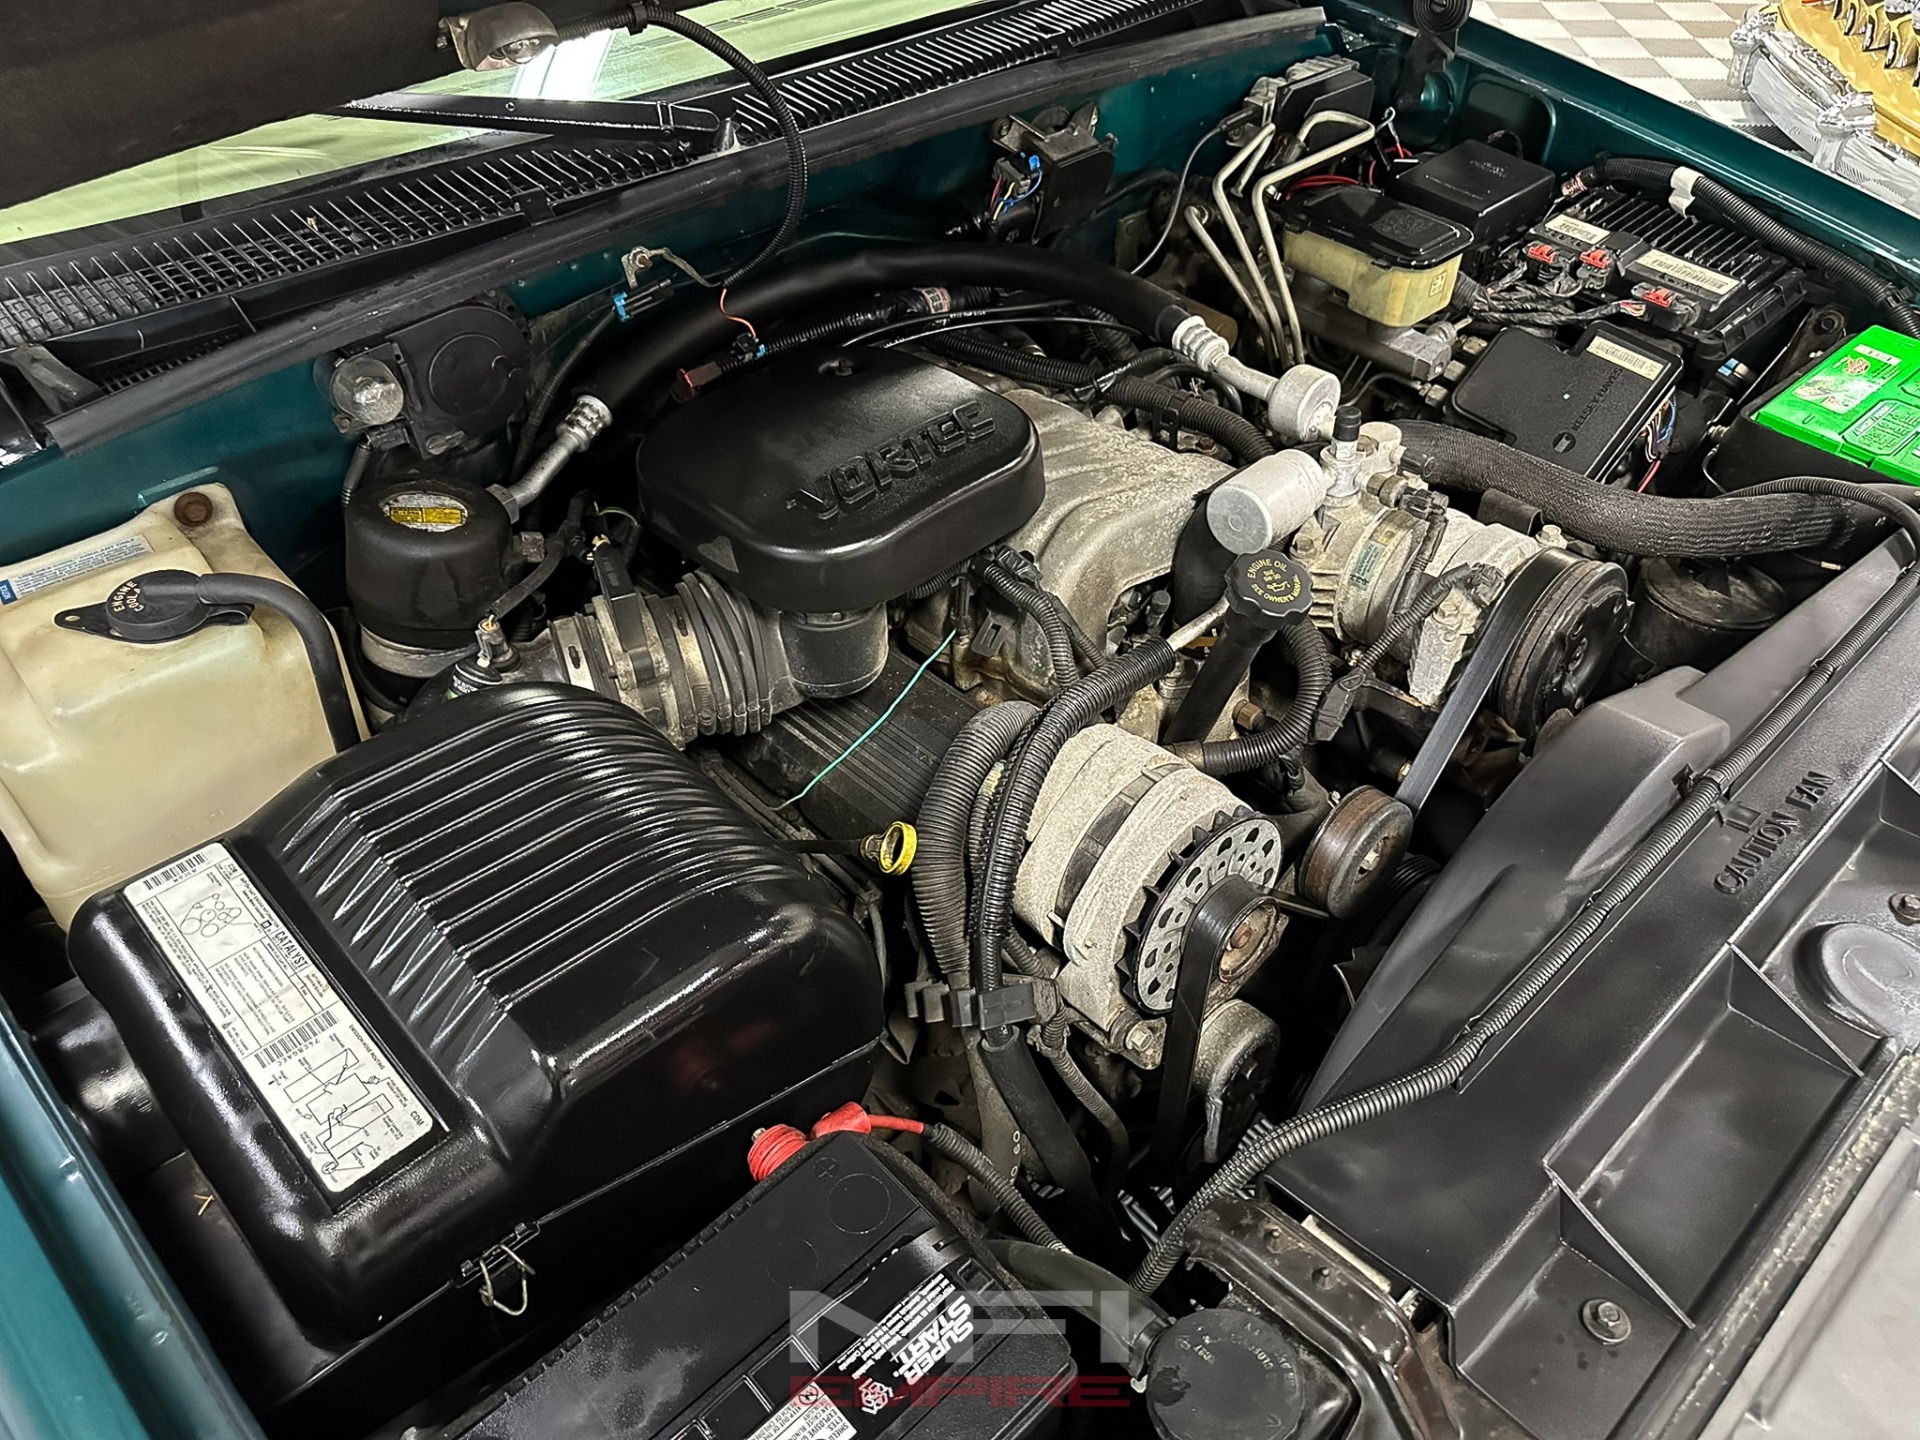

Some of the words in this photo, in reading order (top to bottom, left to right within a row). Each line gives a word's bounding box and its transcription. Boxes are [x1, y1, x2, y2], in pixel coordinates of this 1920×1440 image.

[1571, 397, 1598, 431] KELSEY
[786, 401, 996, 520] VORTEC
[1247, 559, 1272, 579] ENGINE
[1274, 561, 1288, 572] OIL
[113, 581, 138, 612] ENGINE
[1251, 583, 1263, 596] SEE
[1713, 811, 1800, 894] CAUTION
[1785, 771, 1834, 810] FAN
[273, 930, 308, 969] CATALYST
[408, 1109, 425, 1127] CDM
[904, 1317, 974, 1387] SUPER
[779, 1399, 797, 1418] REACH
[788, 1404, 802, 1418] KEEP
[818, 1397, 828, 1407] OR
[819, 1401, 832, 1414] CAN
[773, 1413, 783, 1423] OF
[778, 1415, 790, 1428] OUT
[801, 1402, 820, 1422] INJURY
[804, 1410, 822, 1428] CAUSE
[770, 1424, 780, 1434] OF
[806, 1406, 838, 1439] EXPLOSIVE
[824, 1414, 843, 1433] EYES.
